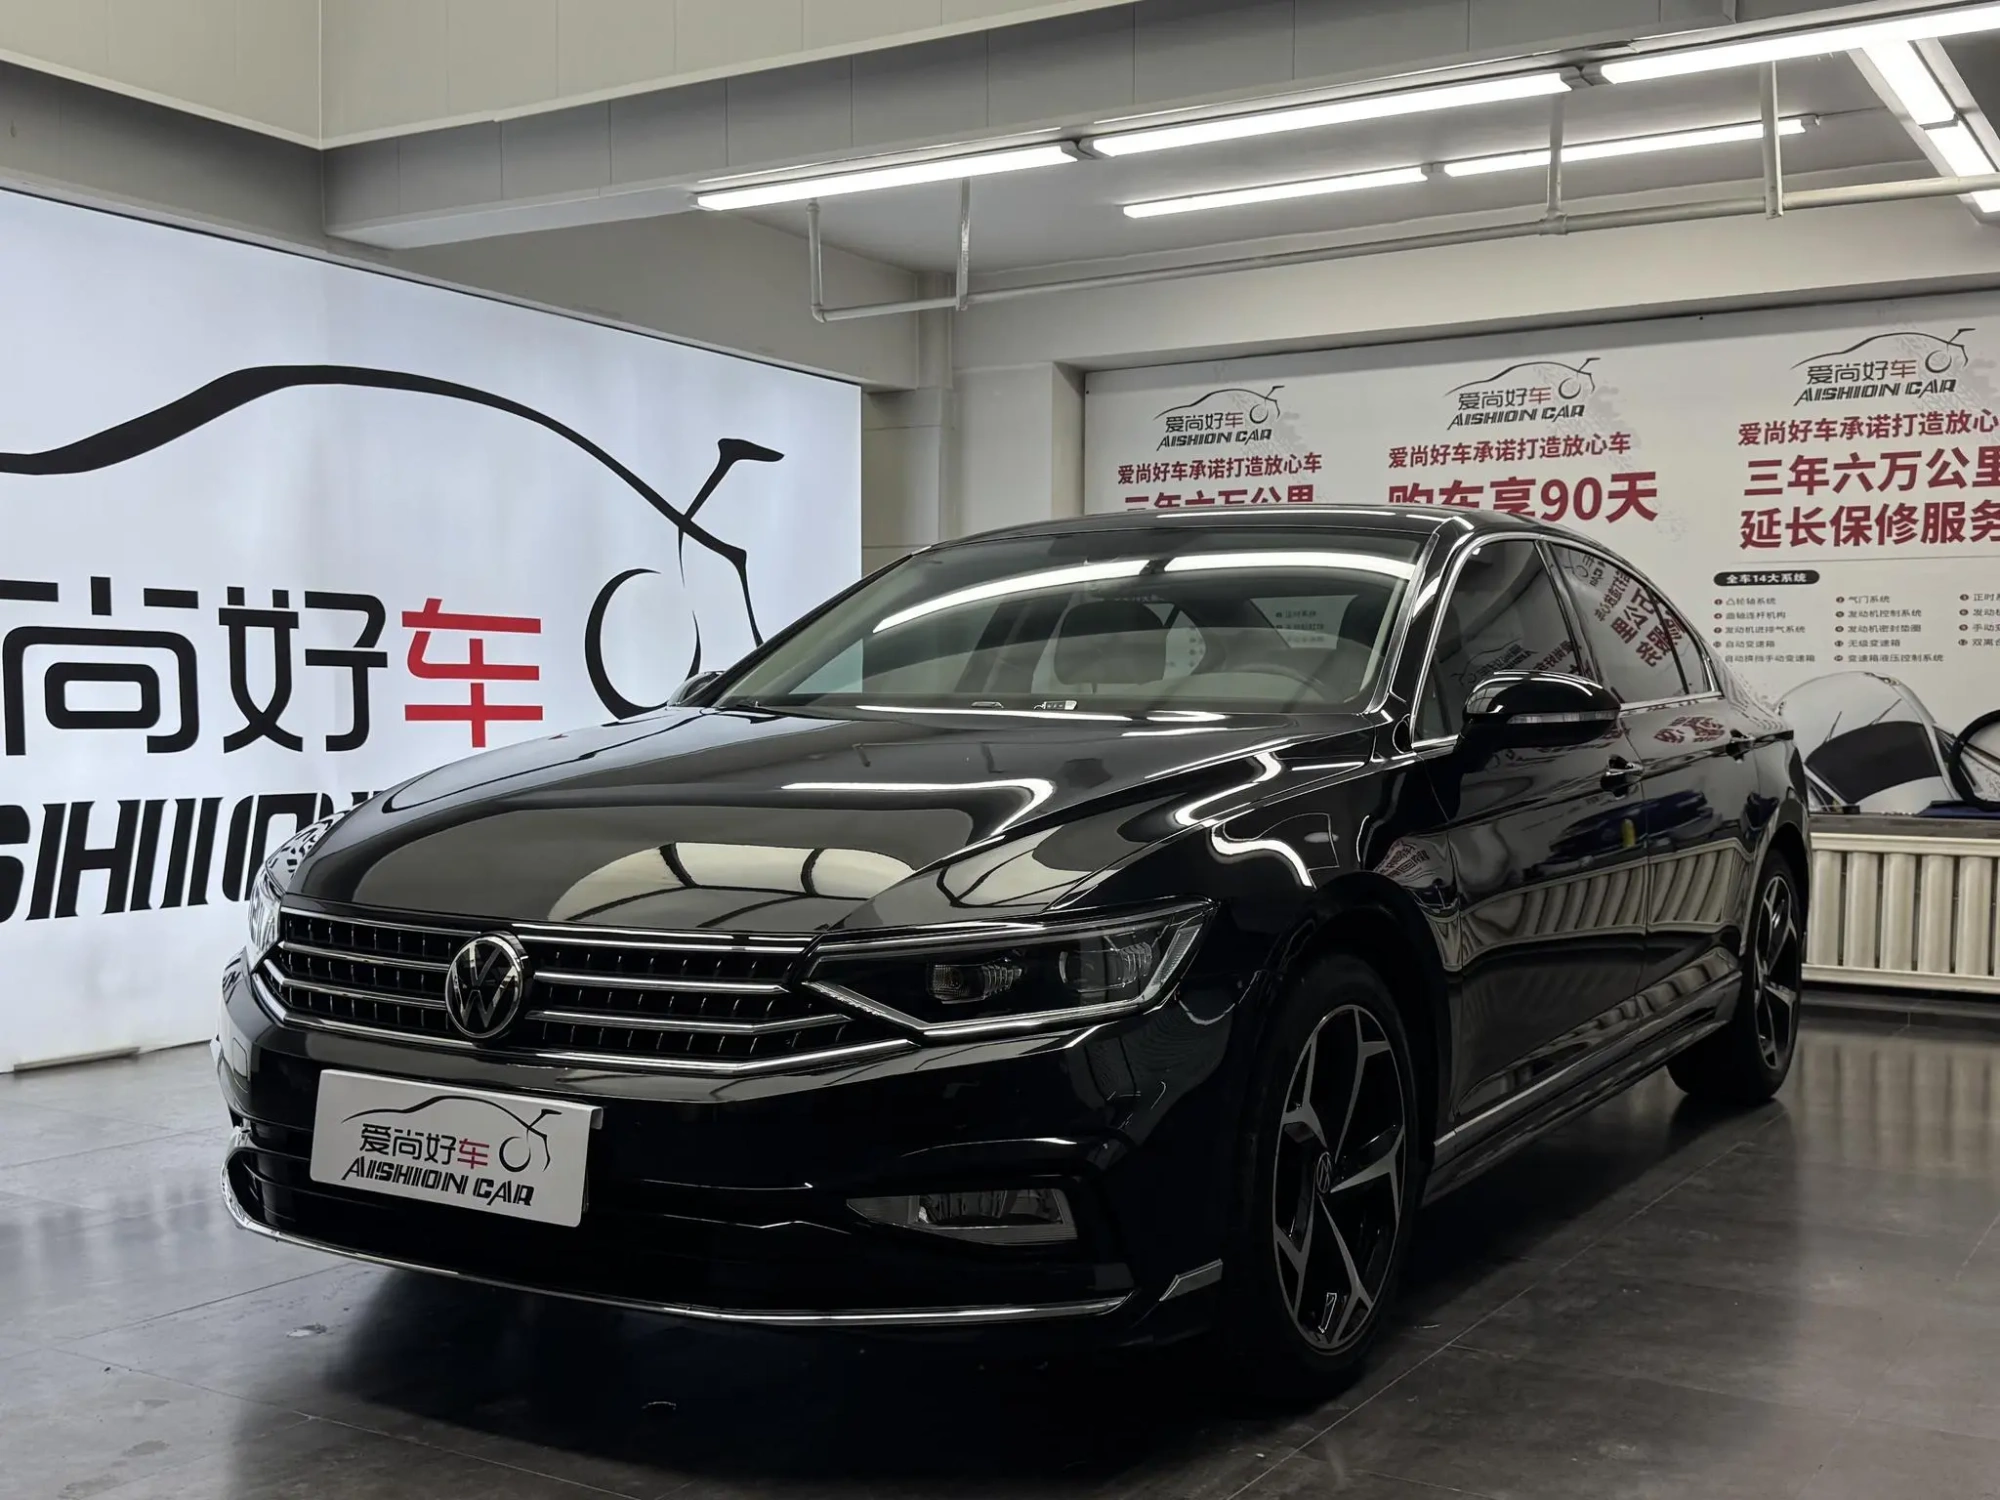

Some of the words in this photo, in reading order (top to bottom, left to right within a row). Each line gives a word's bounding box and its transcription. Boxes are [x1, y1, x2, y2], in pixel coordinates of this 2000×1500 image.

[1805, 359, 1917, 385] 爱尚好车
[1457, 386, 1552, 411] 爱尚好车
[1793, 381, 1900, 407] AISHION
[1904, 378, 1957, 399] CAR
[1165, 411, 1244, 433] 爱尚好车
[1447, 408, 1537, 431] AISHION
[1540, 404, 1585, 423] CAR
[1156, 431, 1233, 451] AISHION
[1235, 428, 1272, 447] CAR
[1388, 431, 1632, 468] 爱尚好车承诺打造放心车
[1117, 452, 1323, 485] 爱尚好车承诺打造放心车
[1743, 445, 2000, 497] 三年六万公里
[1739, 499, 2000, 550] 延长保修服务
[1725, 572, 1808, 585] 全车14大系统
[1847, 595, 1891, 605] 气门系统
[0, 576, 543, 755] 尚好车
[359, 1123, 490, 1170] 爱尚好车
[341, 1155, 470, 1195] AISHION
[472, 1176, 535, 1207] CAR
